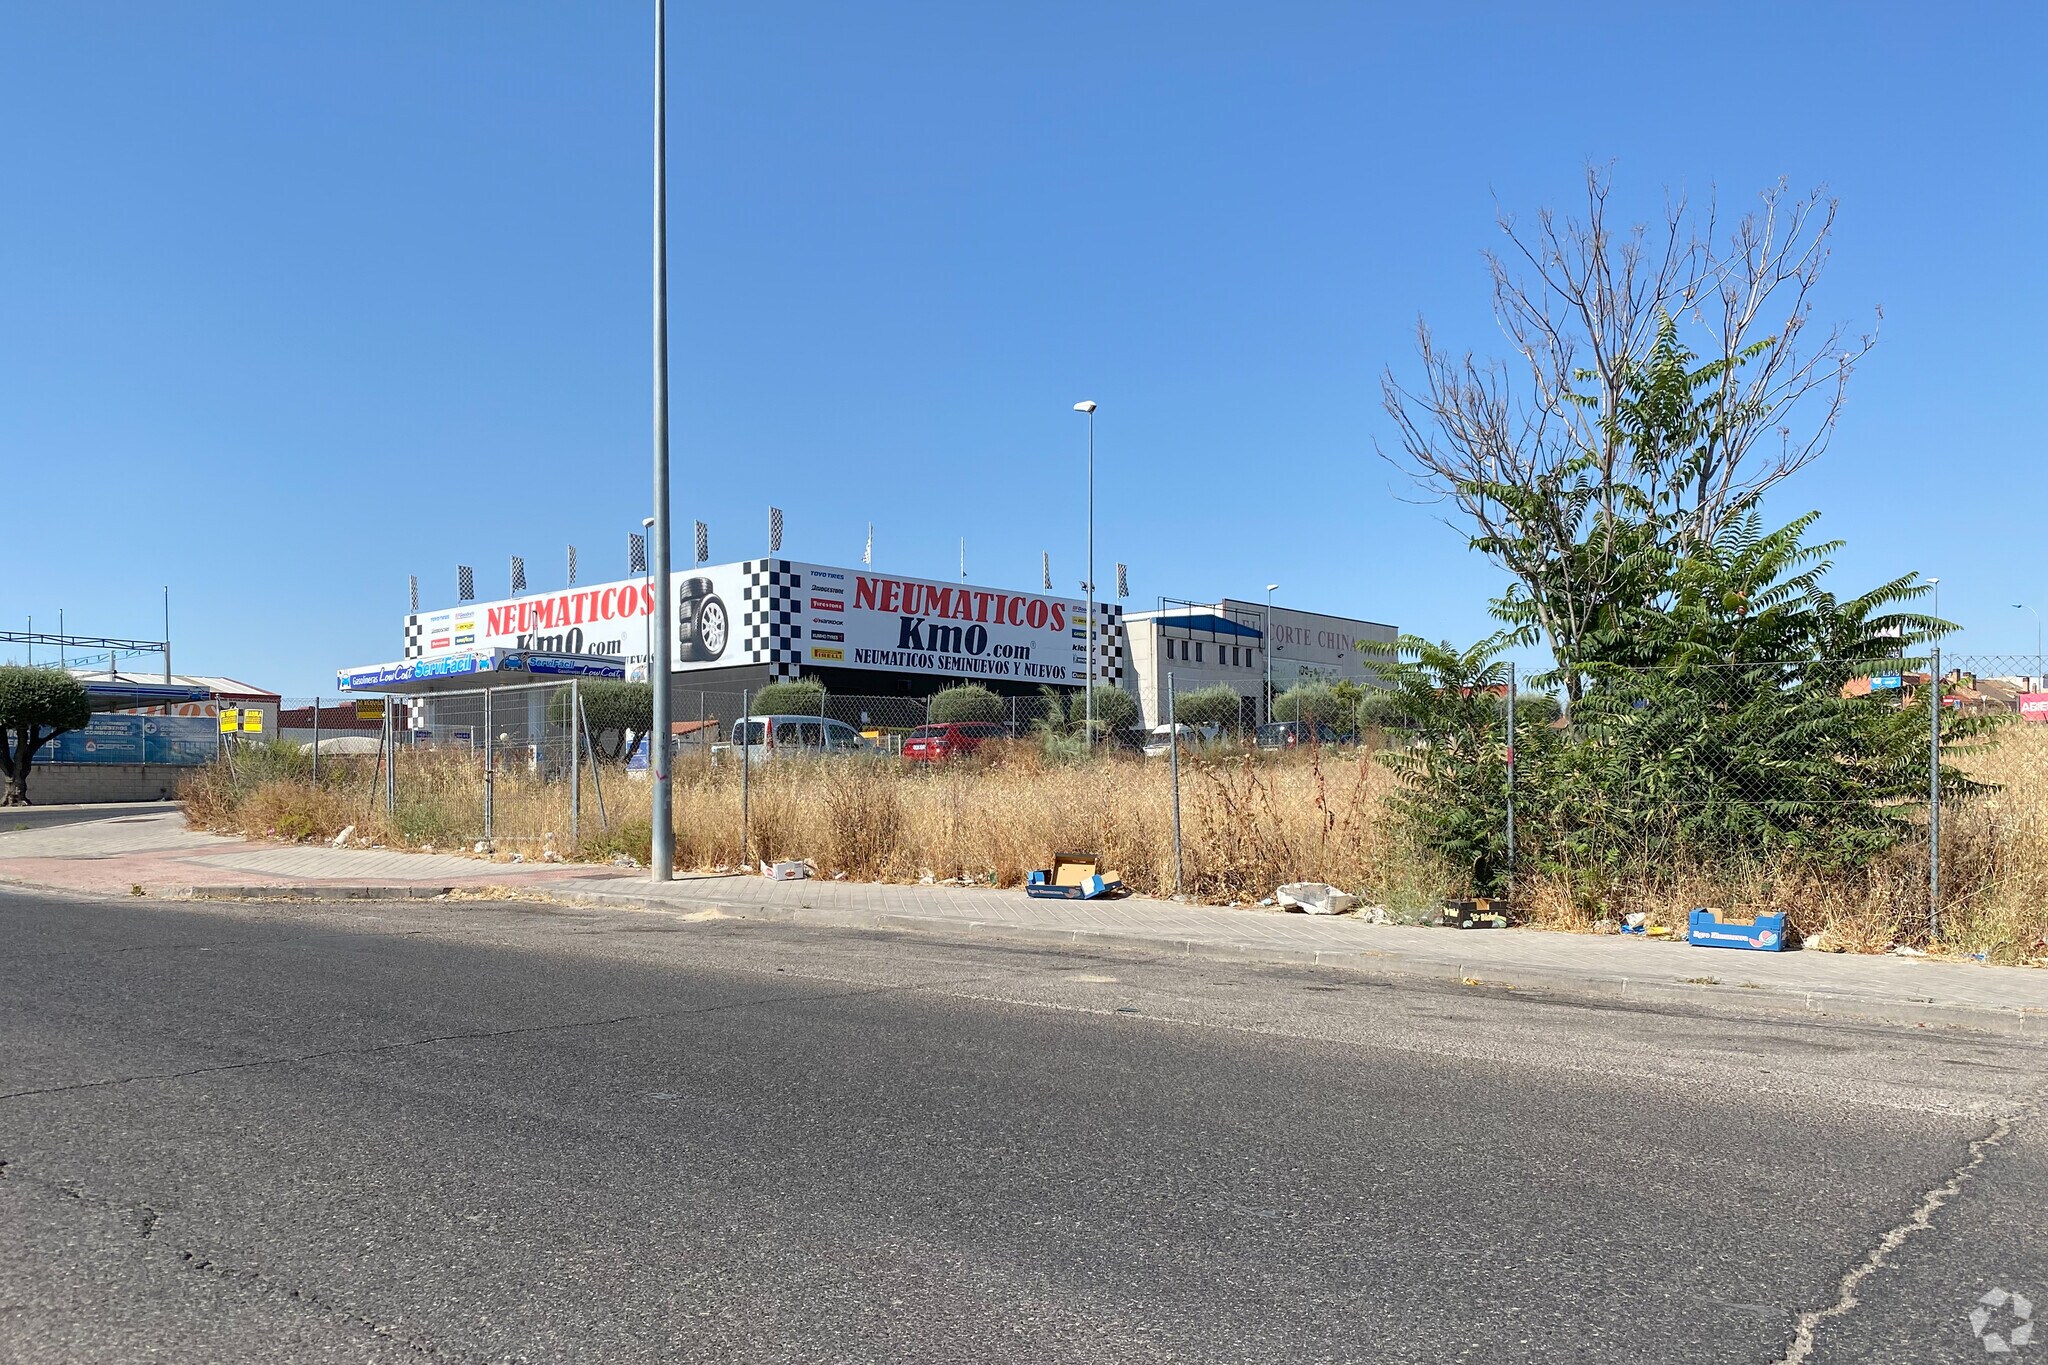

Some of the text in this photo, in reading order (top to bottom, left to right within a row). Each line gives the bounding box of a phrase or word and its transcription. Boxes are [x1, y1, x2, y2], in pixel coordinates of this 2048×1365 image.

[810, 570, 844, 580] TOYO TIRES
[485, 582, 655, 637] NEUMATICOS
[853, 577, 1065, 631] NEUMATICOS
[1318, 630, 1357, 652] CHINA
[814, 649, 842, 659] PIRELLI
[854, 648, 934, 669] NEUMATICOS
[938, 655, 1009, 675] SEMINUEVOS
[1014, 661, 1021, 675] Y
[1024, 662, 1066, 680] NUEVOS
[352, 675, 378, 686] Gasolineras
